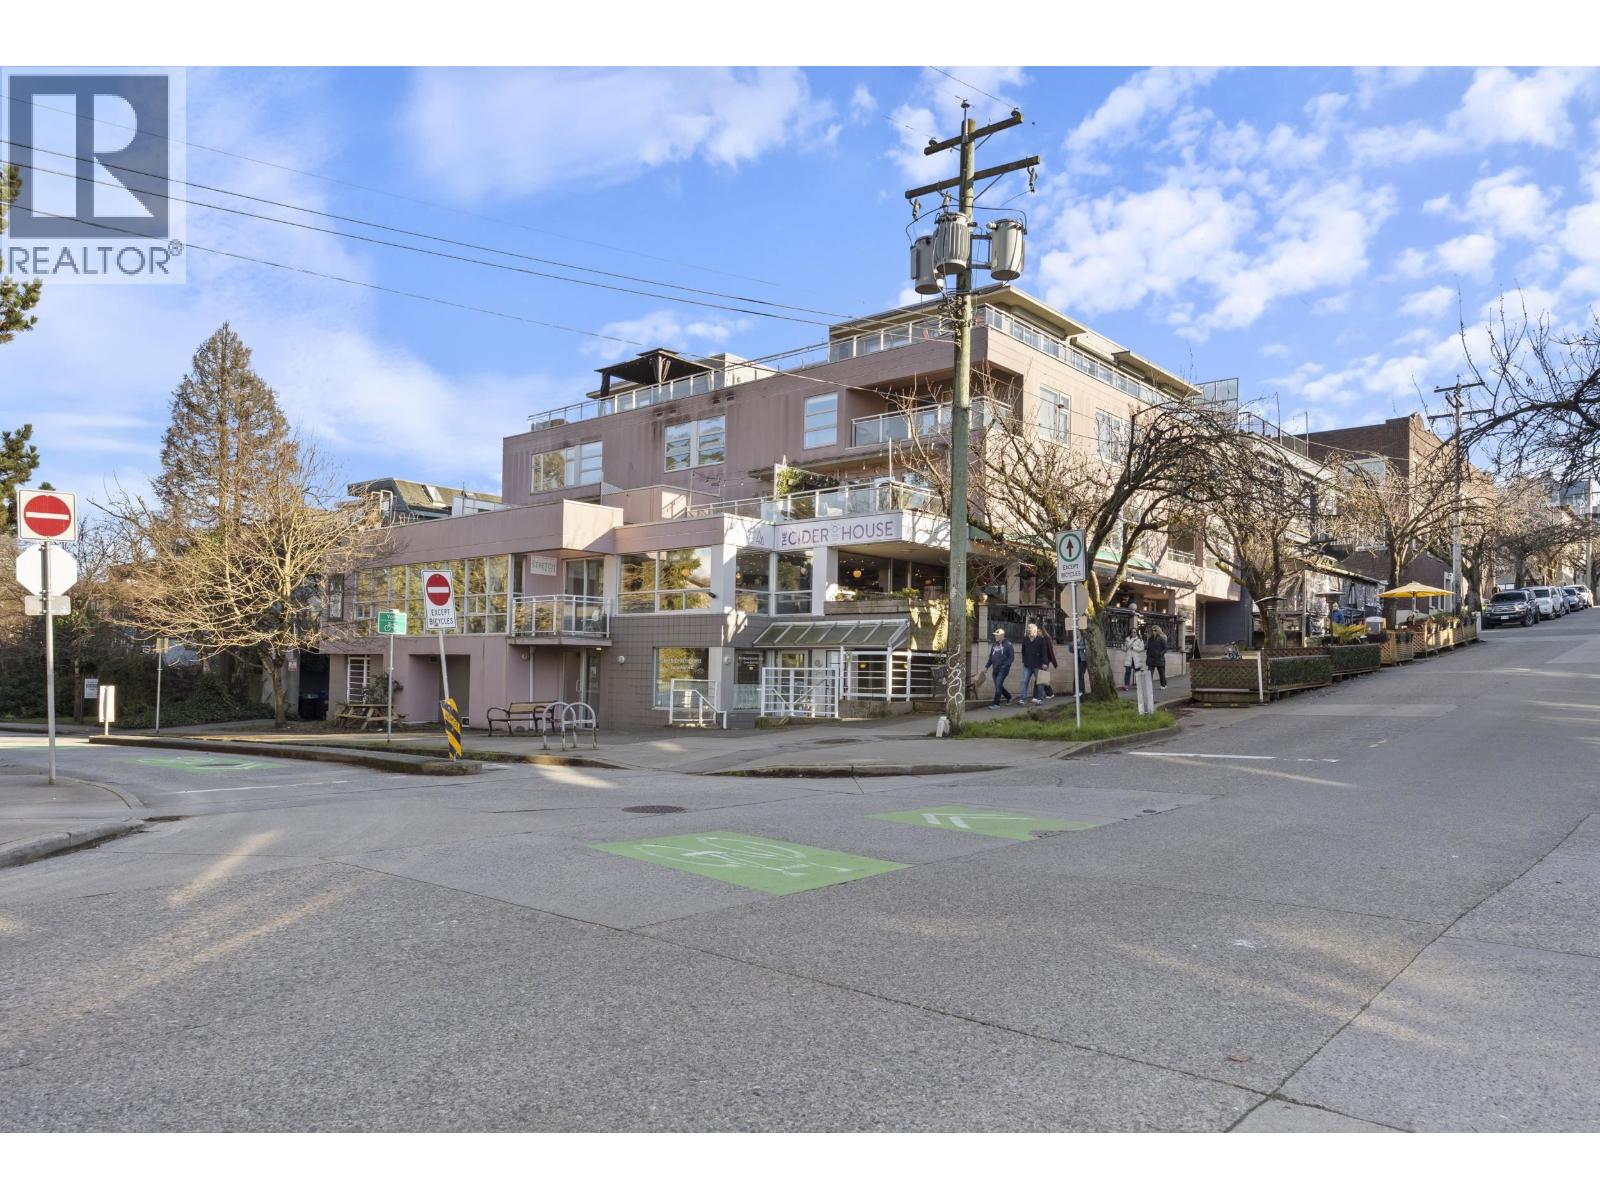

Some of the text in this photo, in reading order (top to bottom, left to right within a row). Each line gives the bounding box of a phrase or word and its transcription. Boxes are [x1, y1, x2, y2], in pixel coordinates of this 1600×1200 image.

[788, 527, 829, 546] CIDER
[841, 521, 894, 541] HOUSE
[1062, 563, 1079, 571] EXCEPT
[430, 608, 451, 616] EXCEPT
[429, 617, 454, 626] BICYCLES
